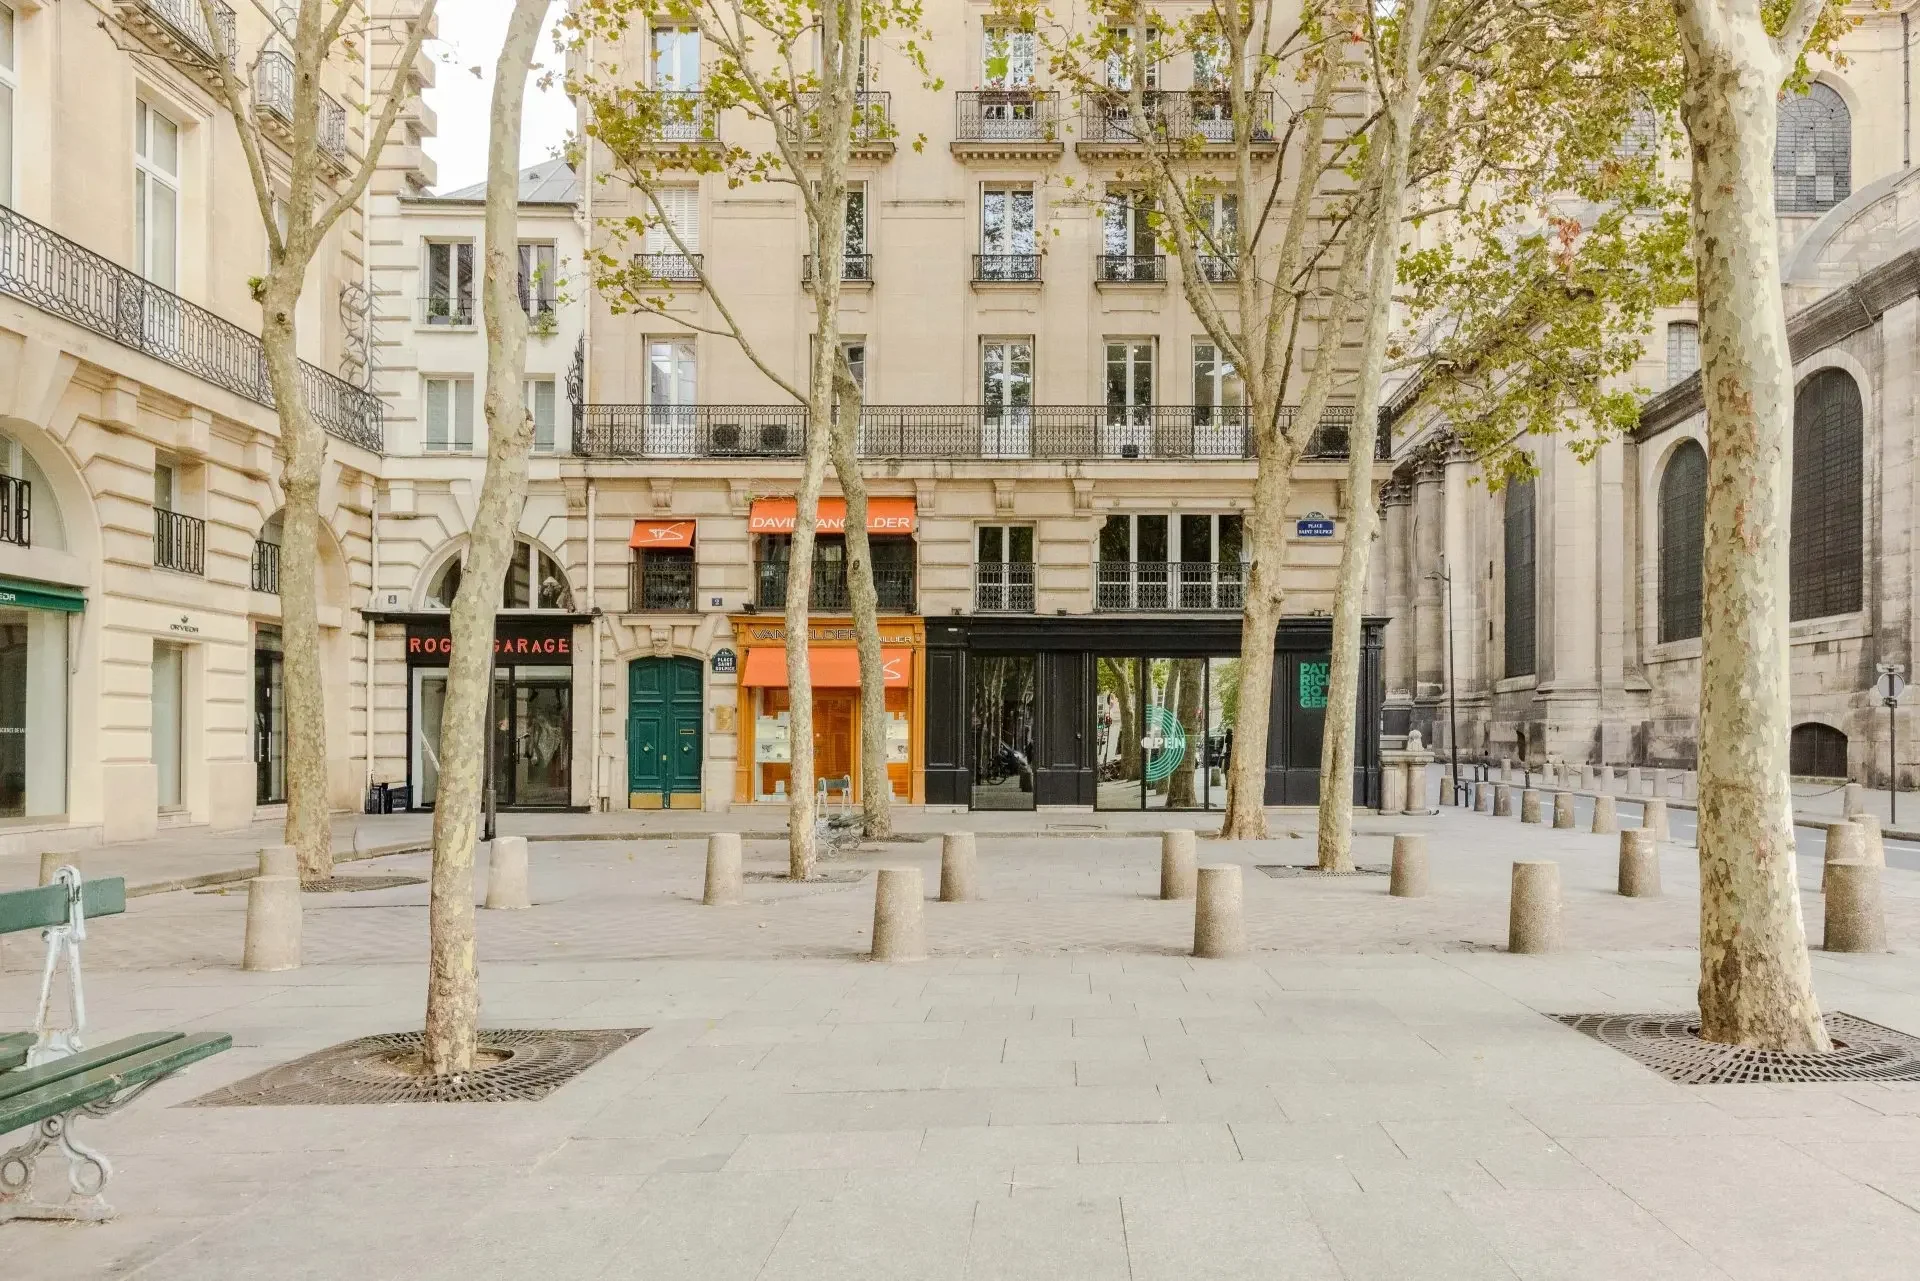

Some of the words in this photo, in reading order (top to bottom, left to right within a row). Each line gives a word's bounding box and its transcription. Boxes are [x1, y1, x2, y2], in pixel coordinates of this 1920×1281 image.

[410, 638, 451, 653] ROG
[1301, 662, 1329, 675] PAT
[1301, 685, 1322, 697] RO
[1141, 737, 1185, 749] OPEN
